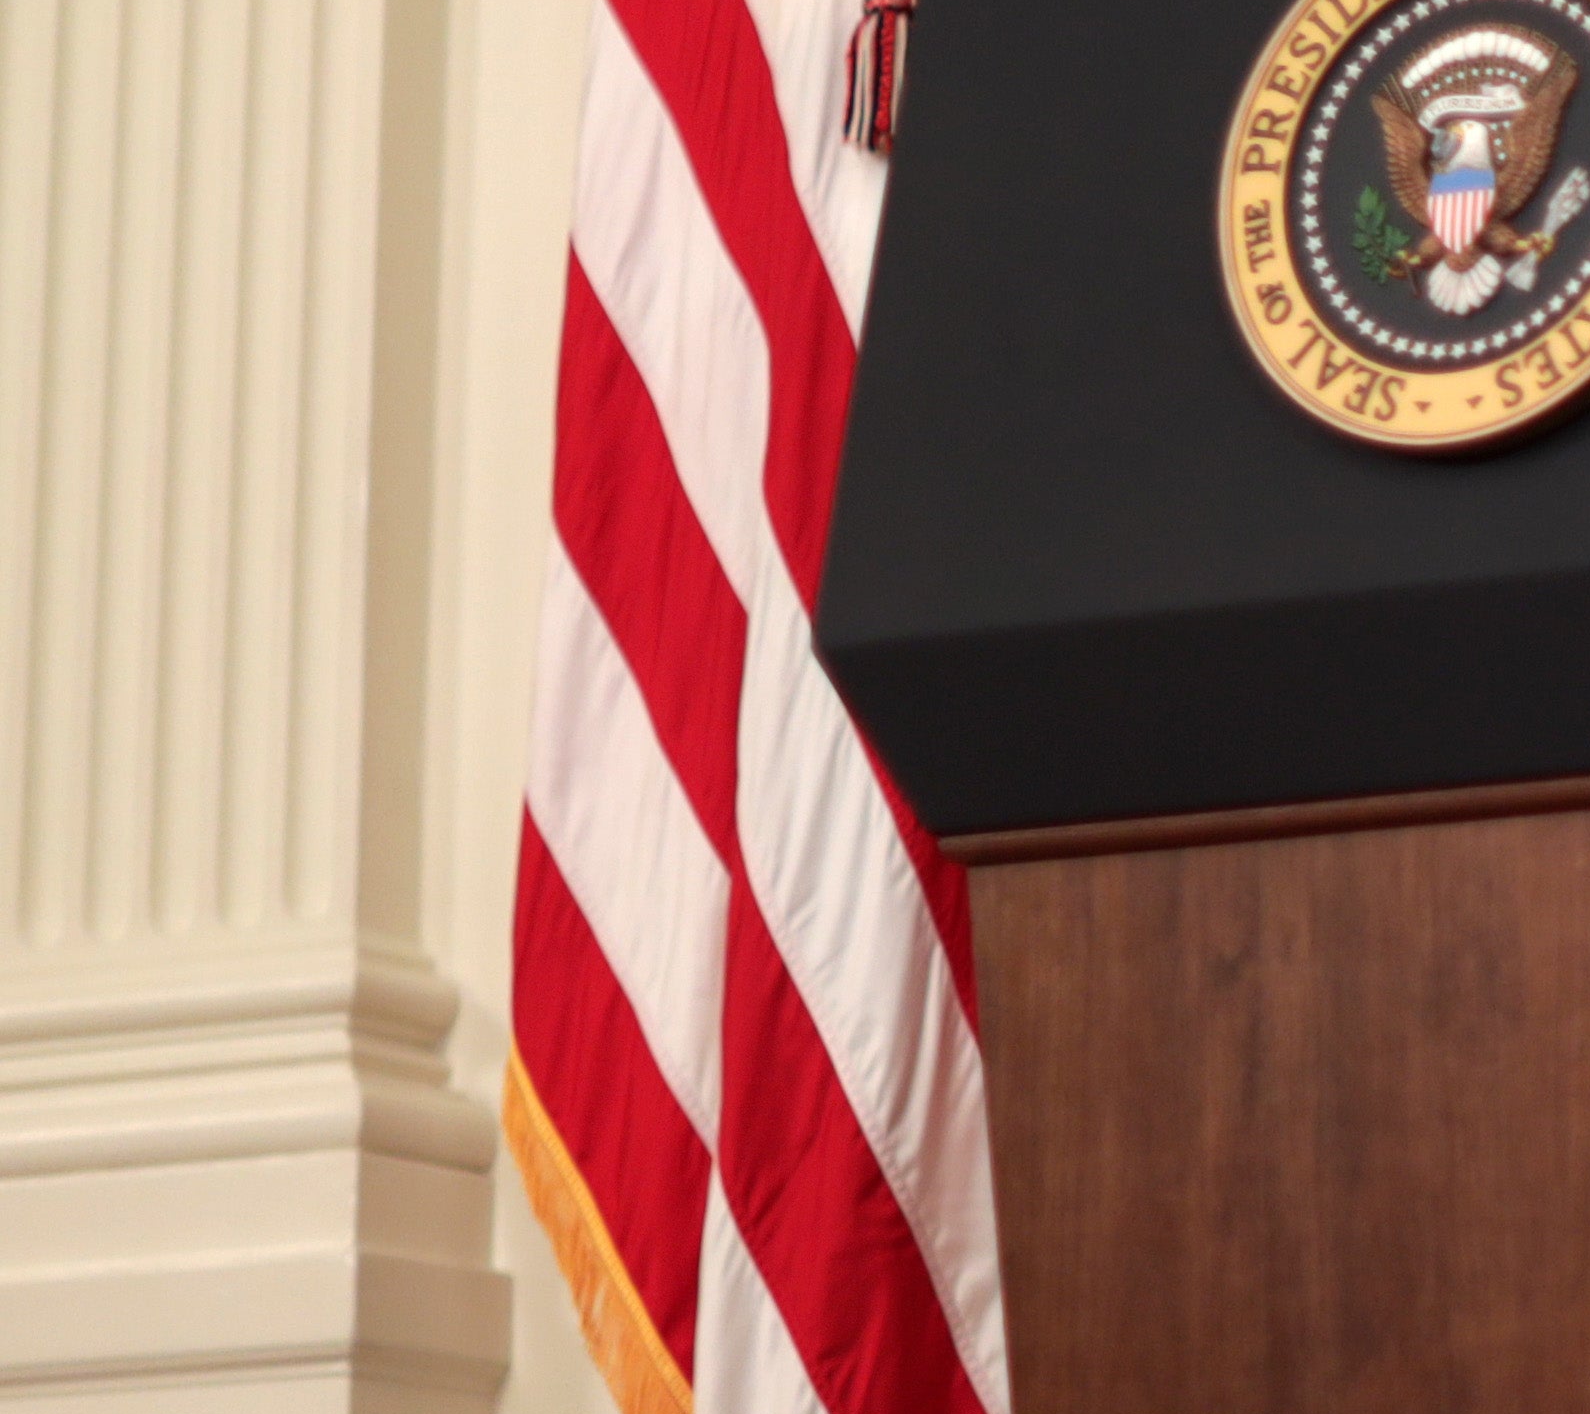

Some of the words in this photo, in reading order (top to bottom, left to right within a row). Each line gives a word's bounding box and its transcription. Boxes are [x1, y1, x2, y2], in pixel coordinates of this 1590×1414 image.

[1243, 199, 1276, 274] THE
[1255, 281, 1293, 325] OF
[1287, 318, 1408, 422] SEAL
